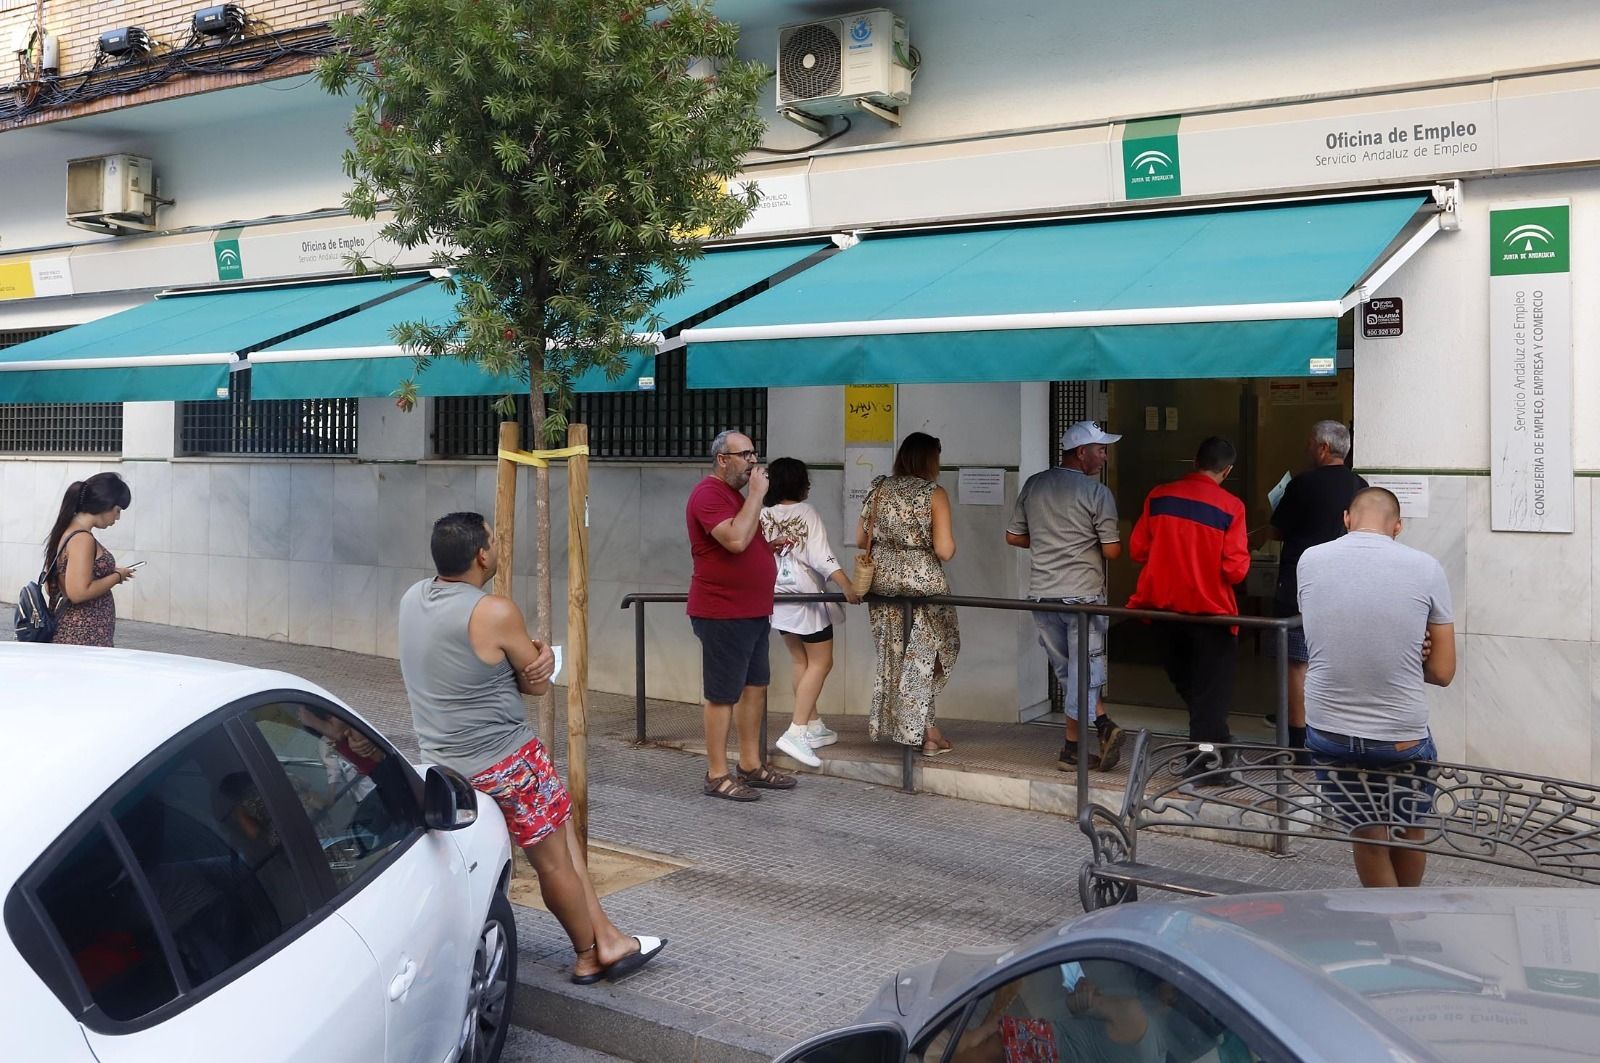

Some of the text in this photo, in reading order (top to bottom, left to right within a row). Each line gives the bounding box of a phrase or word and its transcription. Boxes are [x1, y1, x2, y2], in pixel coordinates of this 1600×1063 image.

[1326, 121, 1477, 150] Oficina de Empleo
[1315, 142, 1478, 167] Servicio Andaluz de Empleo
[301, 236, 365, 252] Oficina de Empleo
[1528, 251, 1556, 259] ANDALUCIA
[1533, 290, 1544, 342] COMERCIO
[1513, 290, 1528, 431] Servicio Andaluz de Empleo
[1533, 351, 1544, 396] EMPRESA
[1533, 398, 1545, 439] EMPLEO,
[1534, 443, 1544, 454] DE
